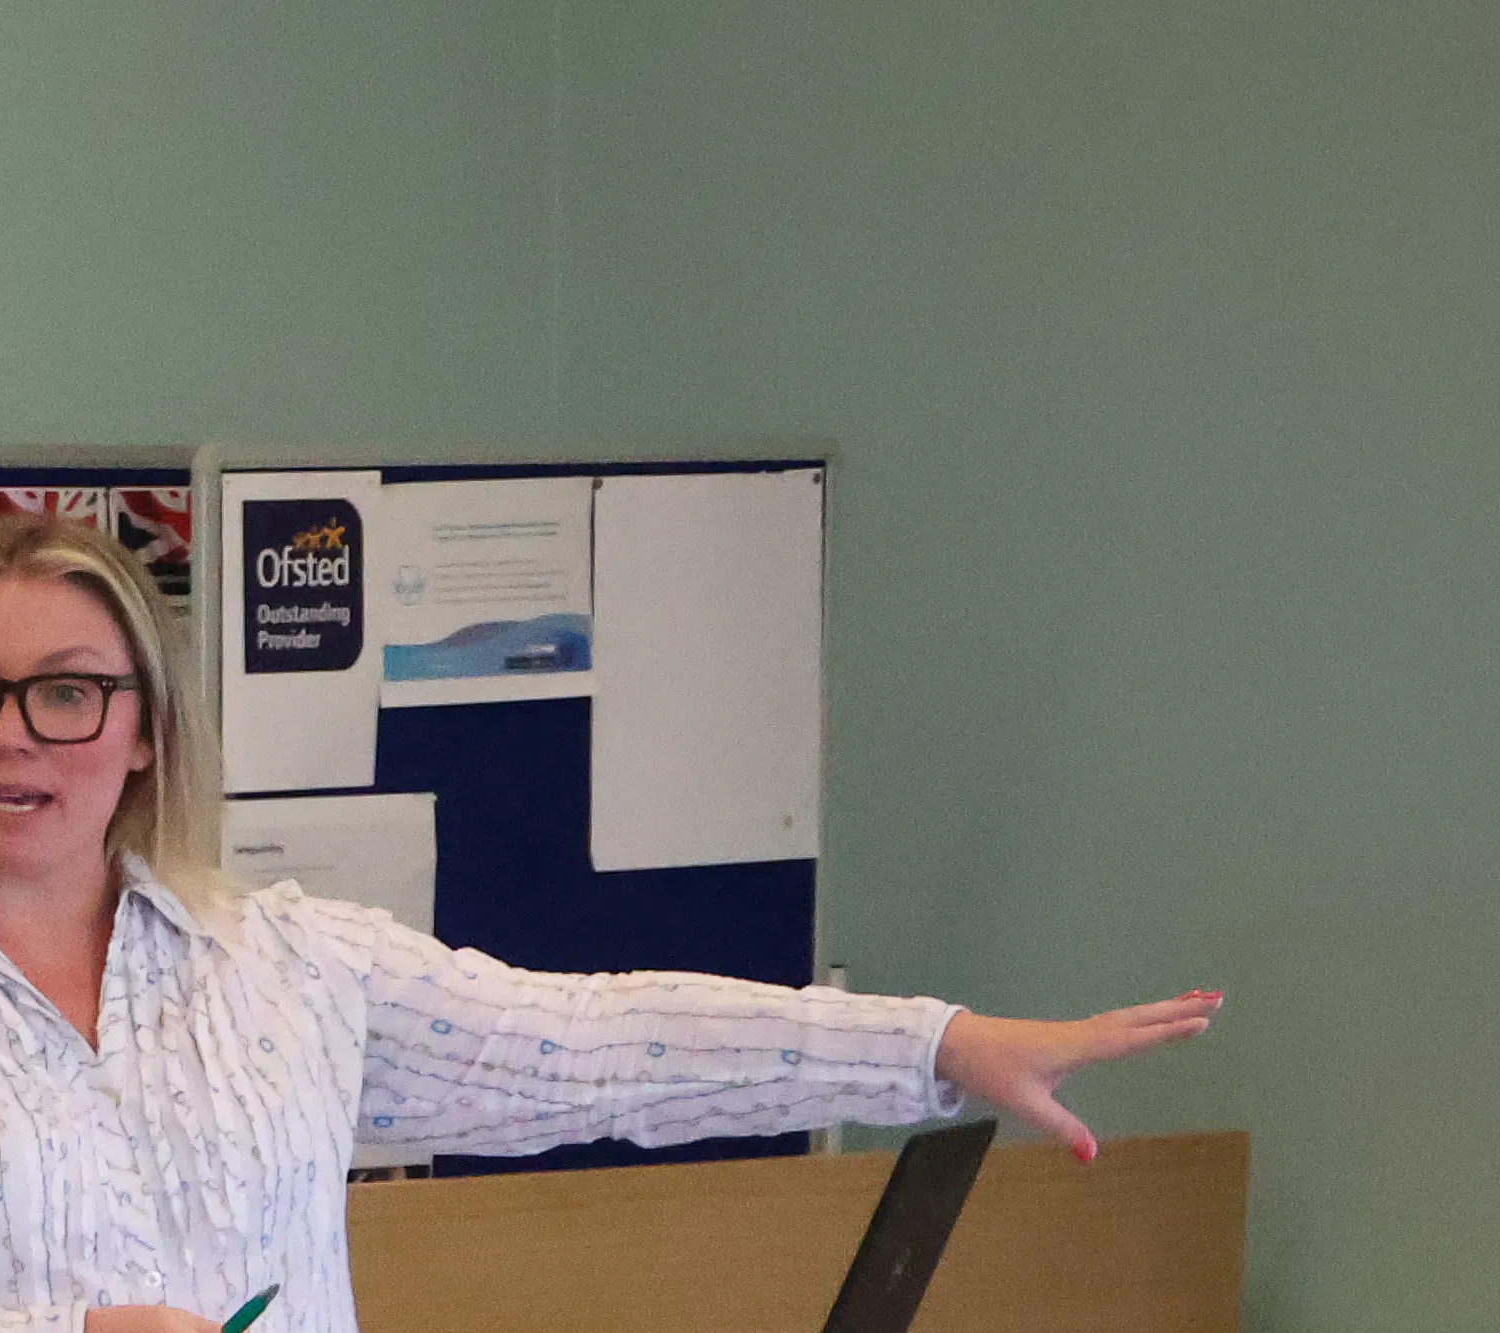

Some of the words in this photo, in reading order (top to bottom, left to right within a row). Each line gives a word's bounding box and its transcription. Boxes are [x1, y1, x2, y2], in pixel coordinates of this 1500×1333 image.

[256, 544, 350, 588] Ofsted
[256, 602, 351, 627] Outstanding
[256, 628, 321, 650] Provider
